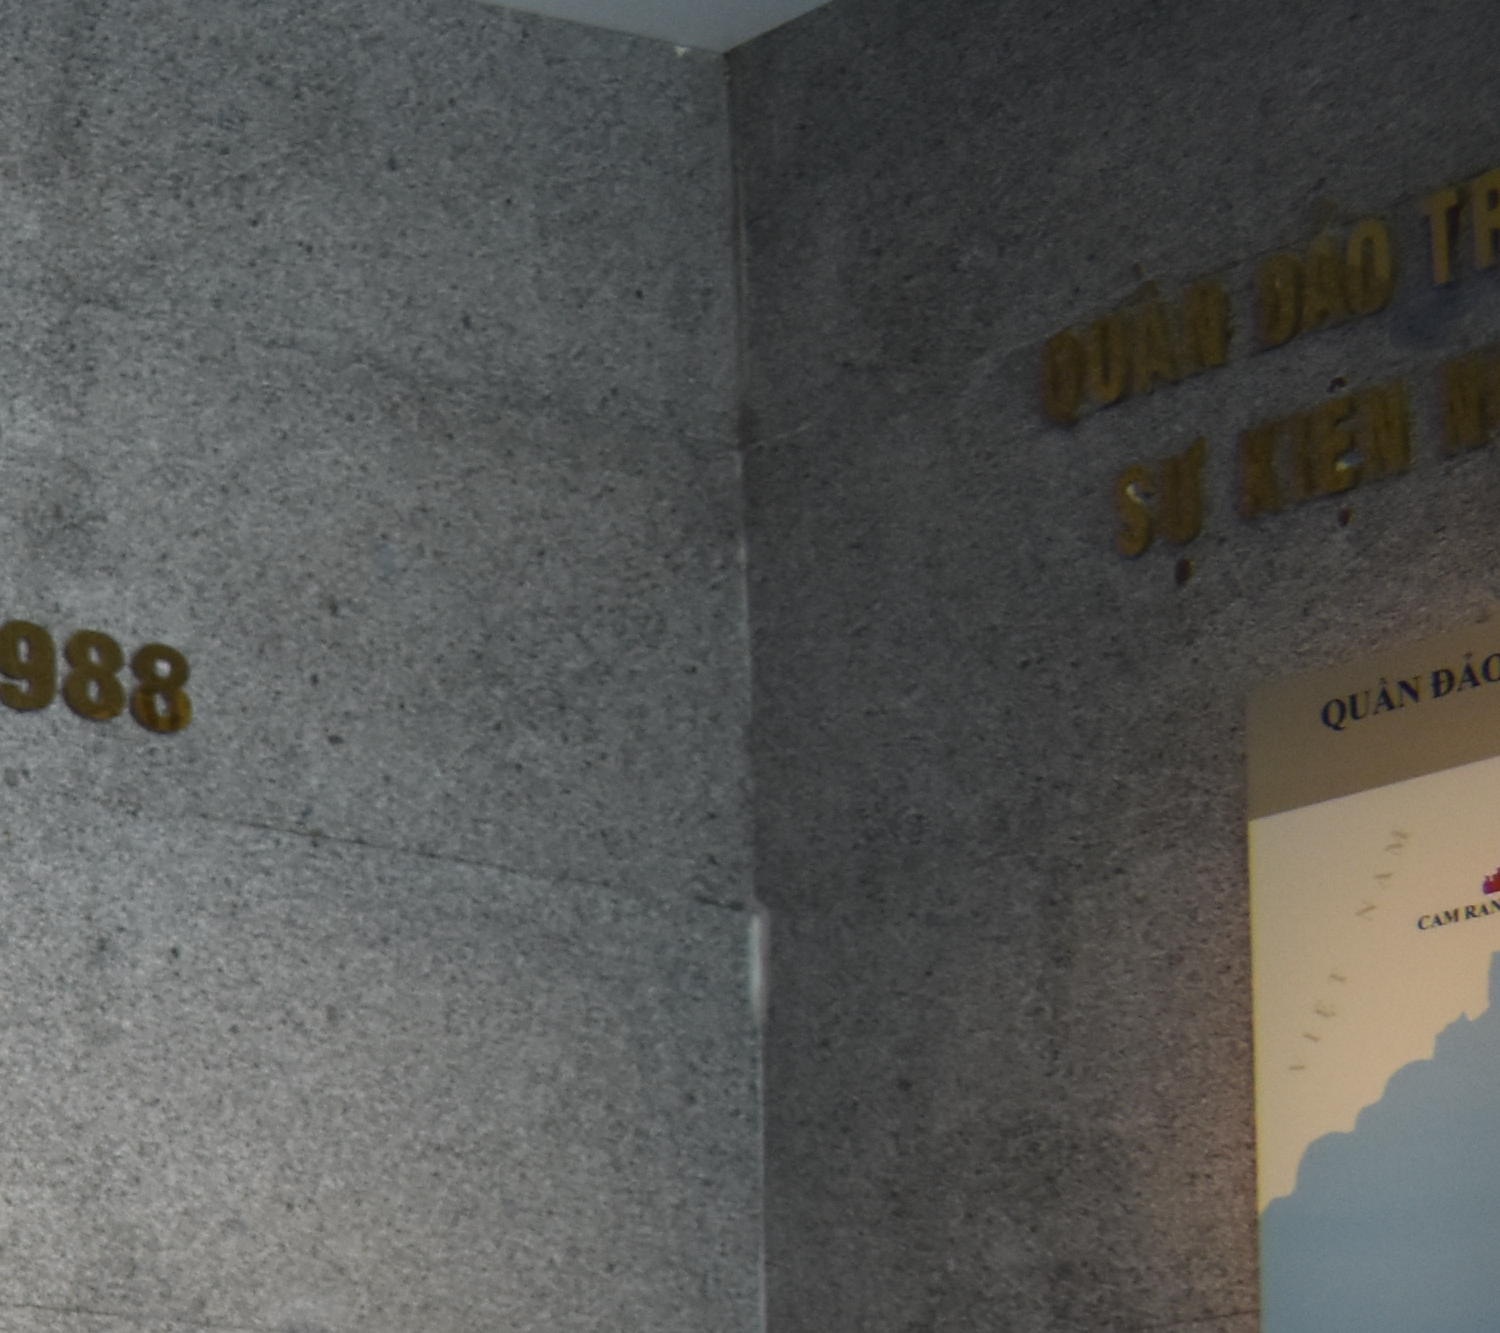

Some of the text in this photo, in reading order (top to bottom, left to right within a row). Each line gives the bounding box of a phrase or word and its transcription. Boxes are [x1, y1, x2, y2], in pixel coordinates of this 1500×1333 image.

[1239, 375, 1413, 528] KIỆN
[1321, 675, 1422, 731] QUẦN
[1417, 907, 1460, 931] CAM
